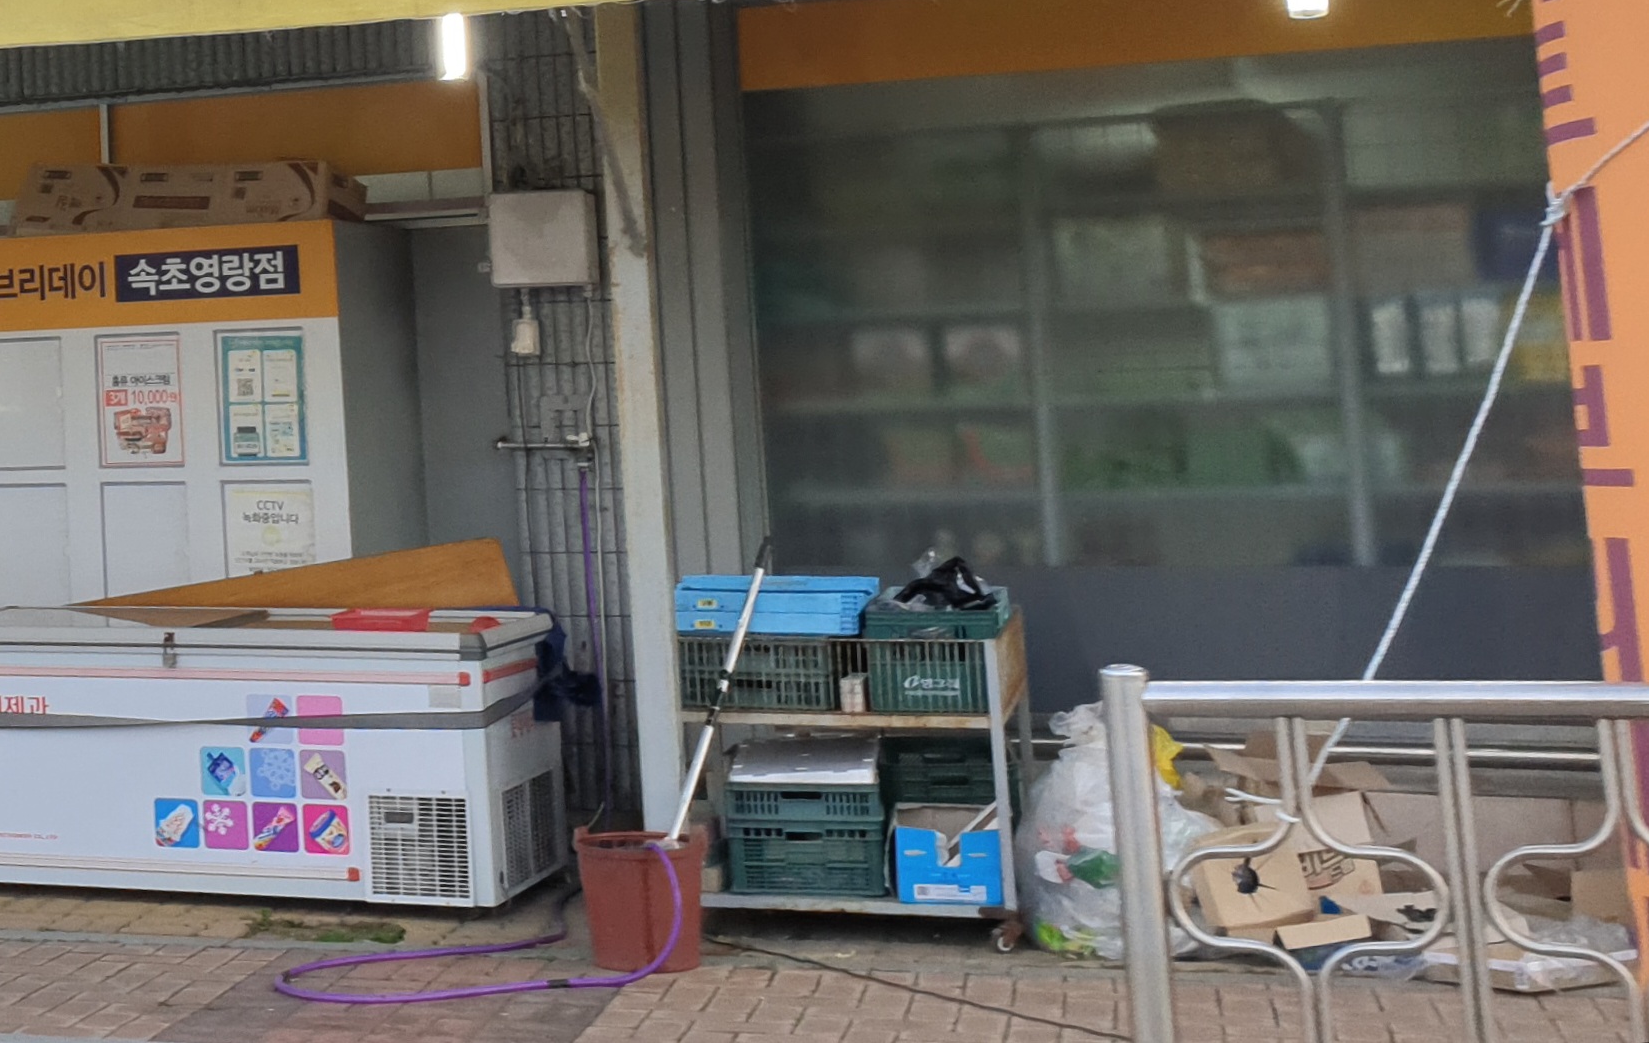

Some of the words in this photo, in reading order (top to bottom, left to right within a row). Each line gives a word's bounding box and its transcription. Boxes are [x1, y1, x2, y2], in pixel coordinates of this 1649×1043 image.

[126, 250, 286, 296] 속초영랑점
[256, 500, 284, 511] CCTV
[242, 512, 299, 524] 녹화중입니다
